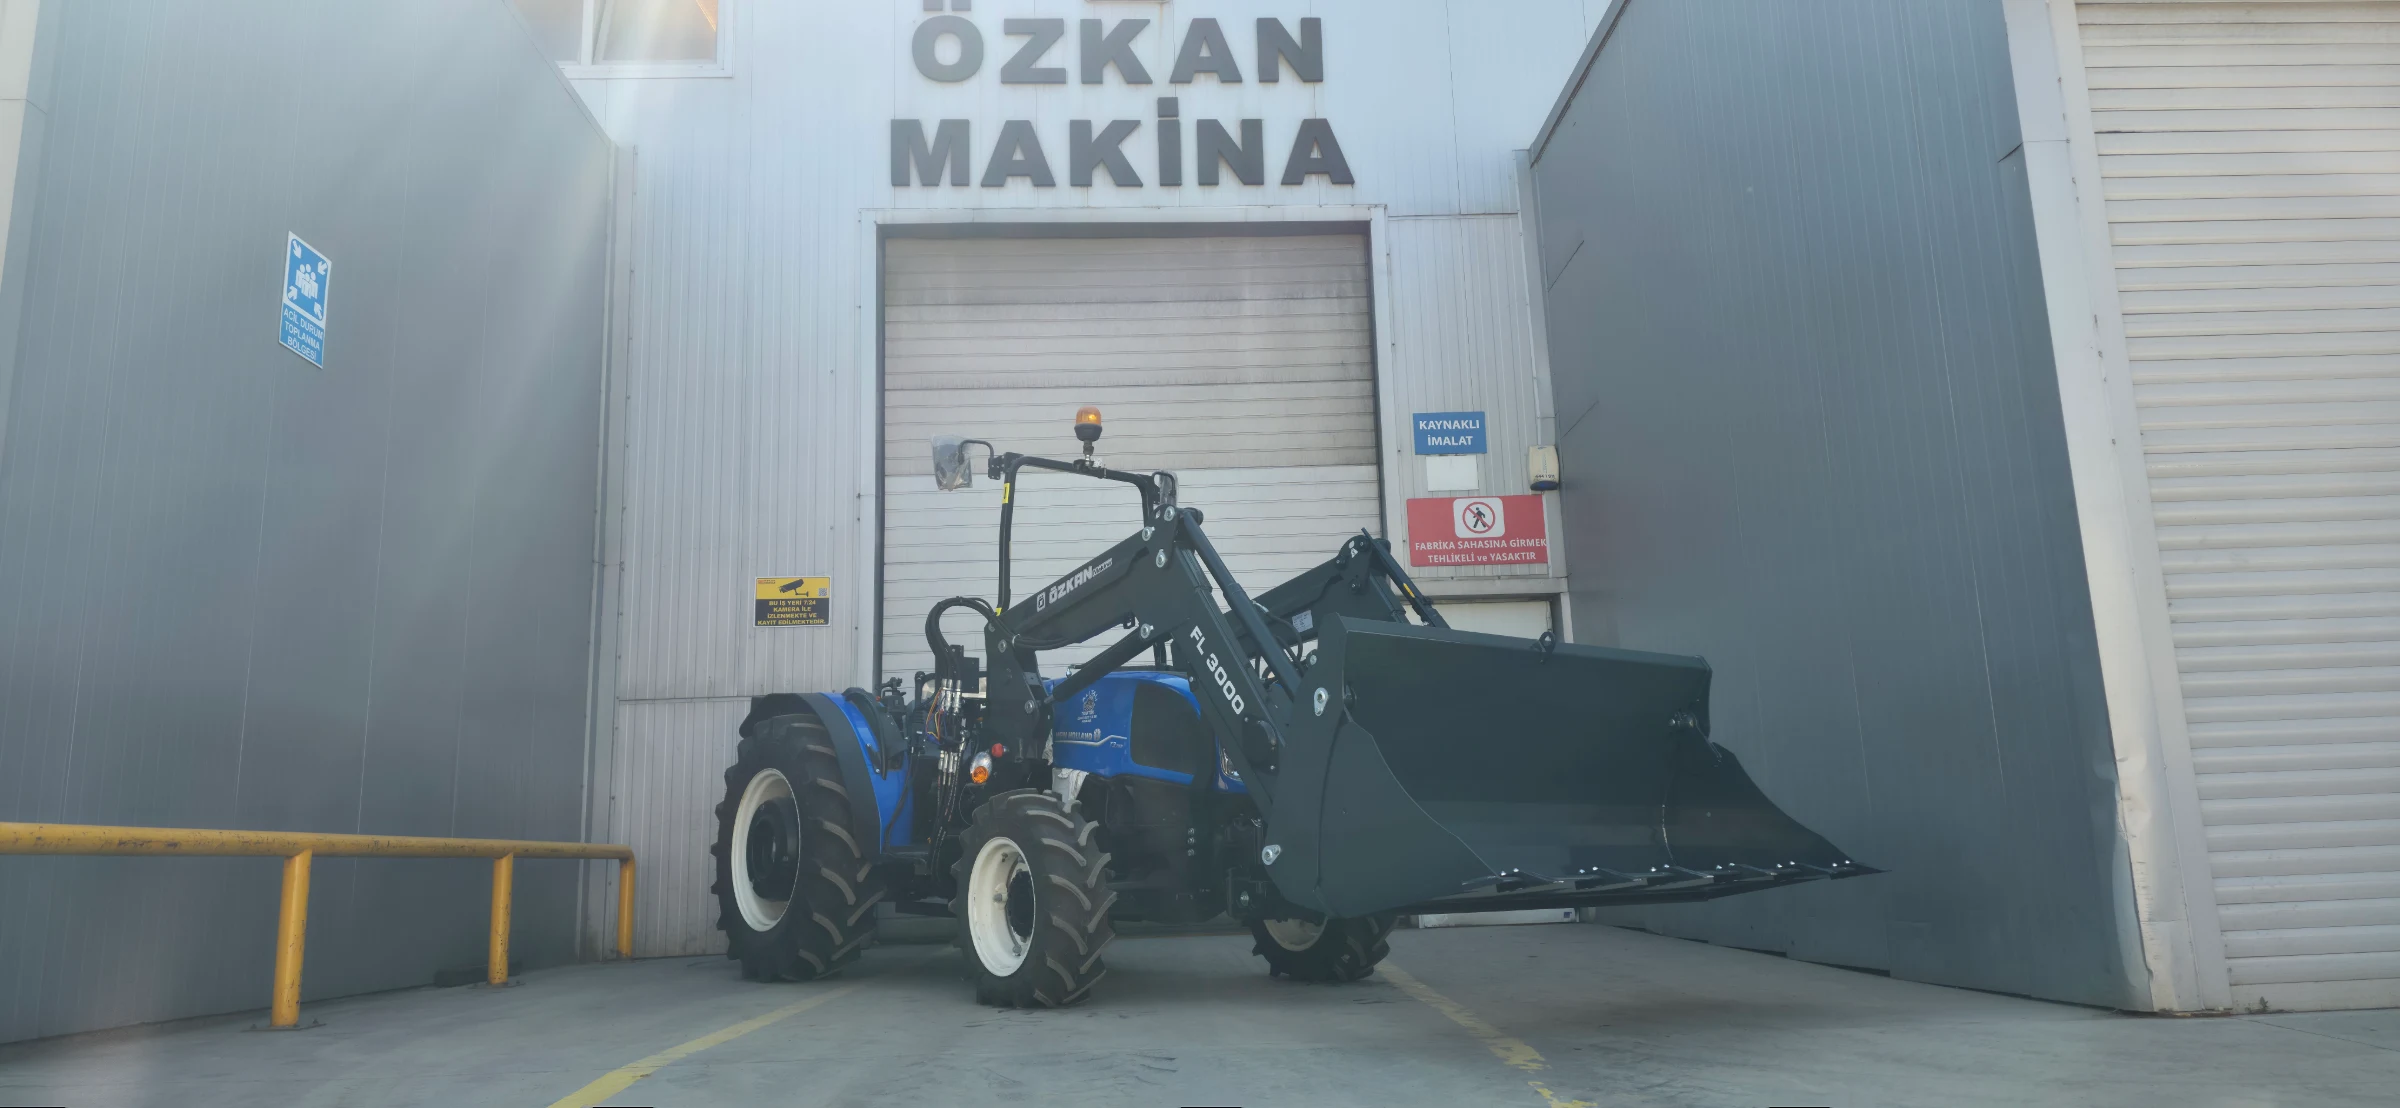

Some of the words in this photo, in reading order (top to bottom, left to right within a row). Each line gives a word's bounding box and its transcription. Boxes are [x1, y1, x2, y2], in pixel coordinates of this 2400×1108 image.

[911, 0, 1323, 84] ÖZKAN
[890, 96, 1355, 188] MAKİNA
[284, 307, 299, 325] ACİL
[300, 317, 323, 340] DURUM
[285, 320, 320, 351] TOPLANMA
[287, 335, 317, 361] BÖLGESİ
[1419, 419, 1480, 430] KAYNAKLI
[1427, 434, 1473, 446] İMALAT
[1415, 540, 1456, 551] FABRİKA
[1457, 538, 1507, 549] SAHASINA
[1509, 537, 1547, 547] GİRMEK
[1427, 551, 1475, 563] TEHLİKELİ
[1489, 551, 1536, 561] YASAKTIR
[1048, 565, 1093, 605] ÖZKAN
[1190, 625, 1206, 656] FL
[1206, 652, 1245, 715] 3000
